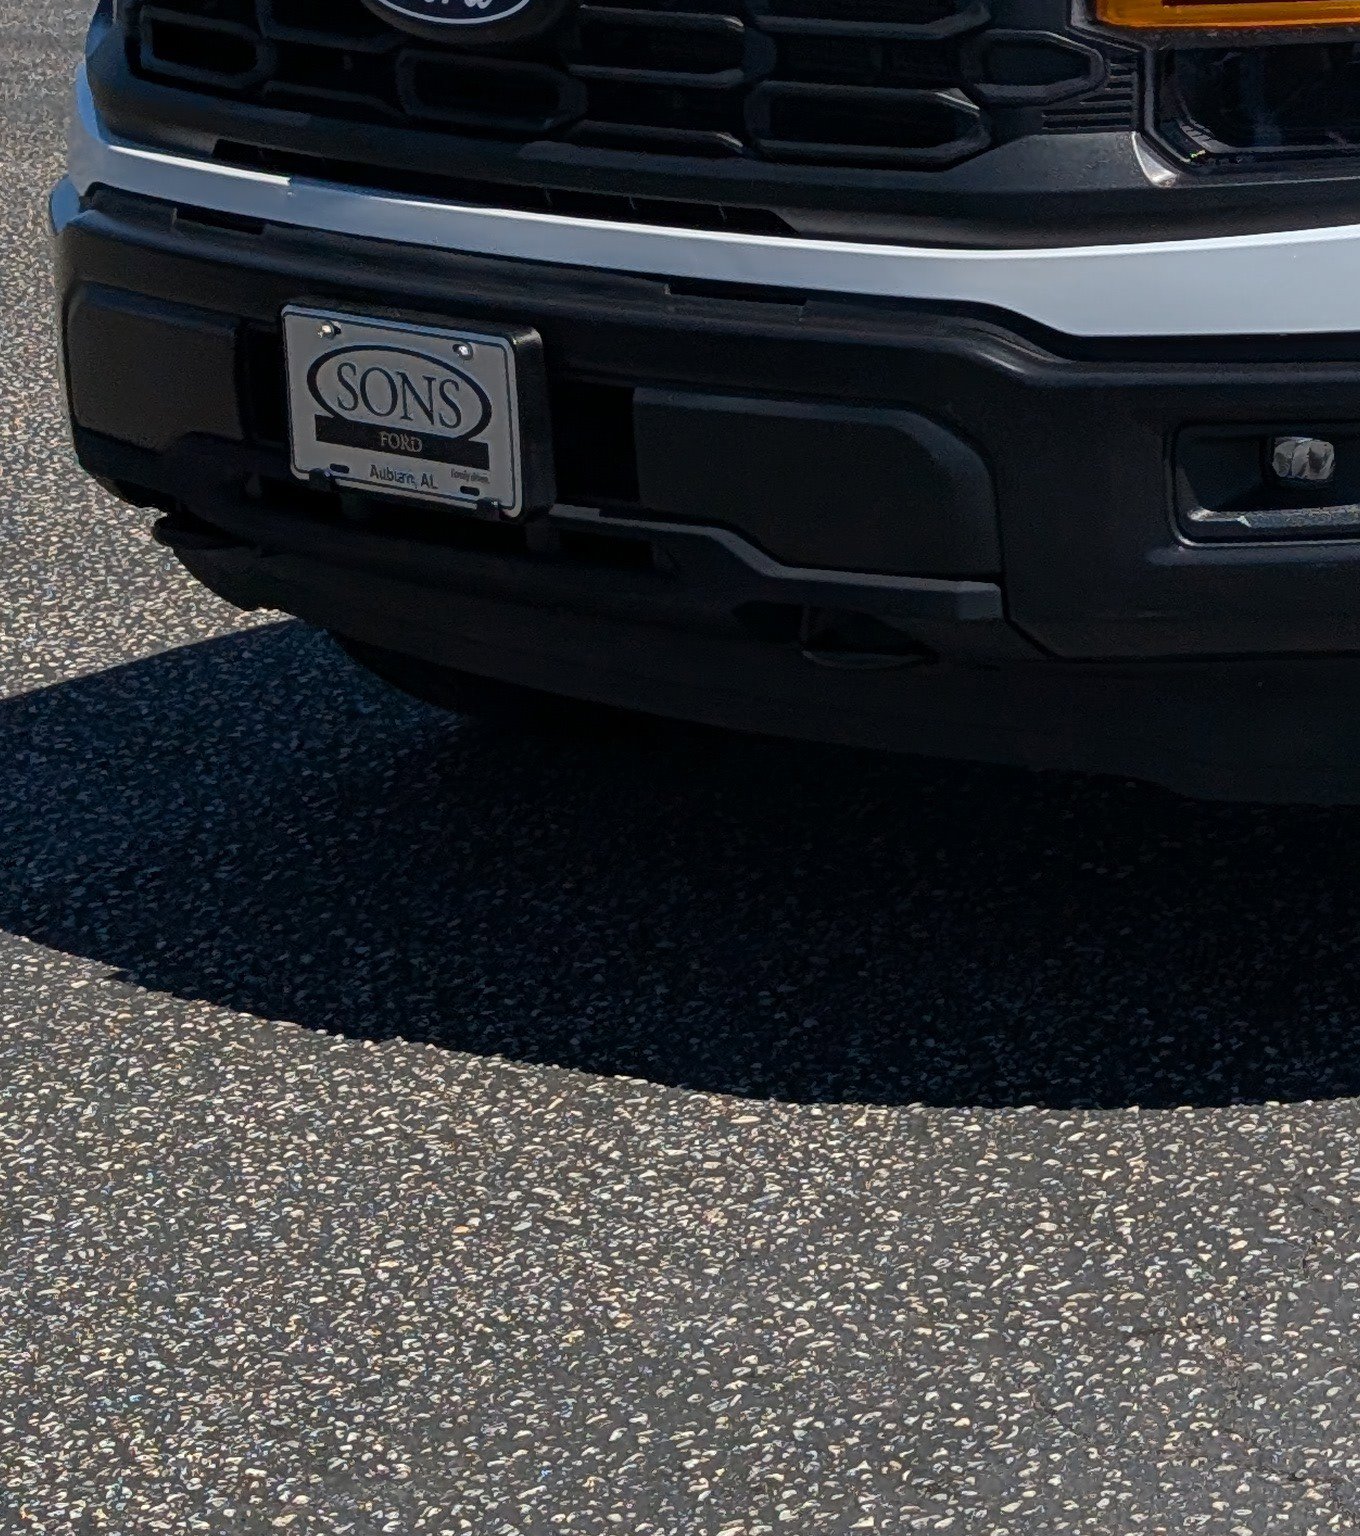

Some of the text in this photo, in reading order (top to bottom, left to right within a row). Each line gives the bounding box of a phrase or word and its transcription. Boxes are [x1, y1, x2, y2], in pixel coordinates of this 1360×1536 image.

[337, 362, 462, 429] SONS
[379, 431, 423, 453] FORD
[369, 464, 439, 490] Auburn, AL
